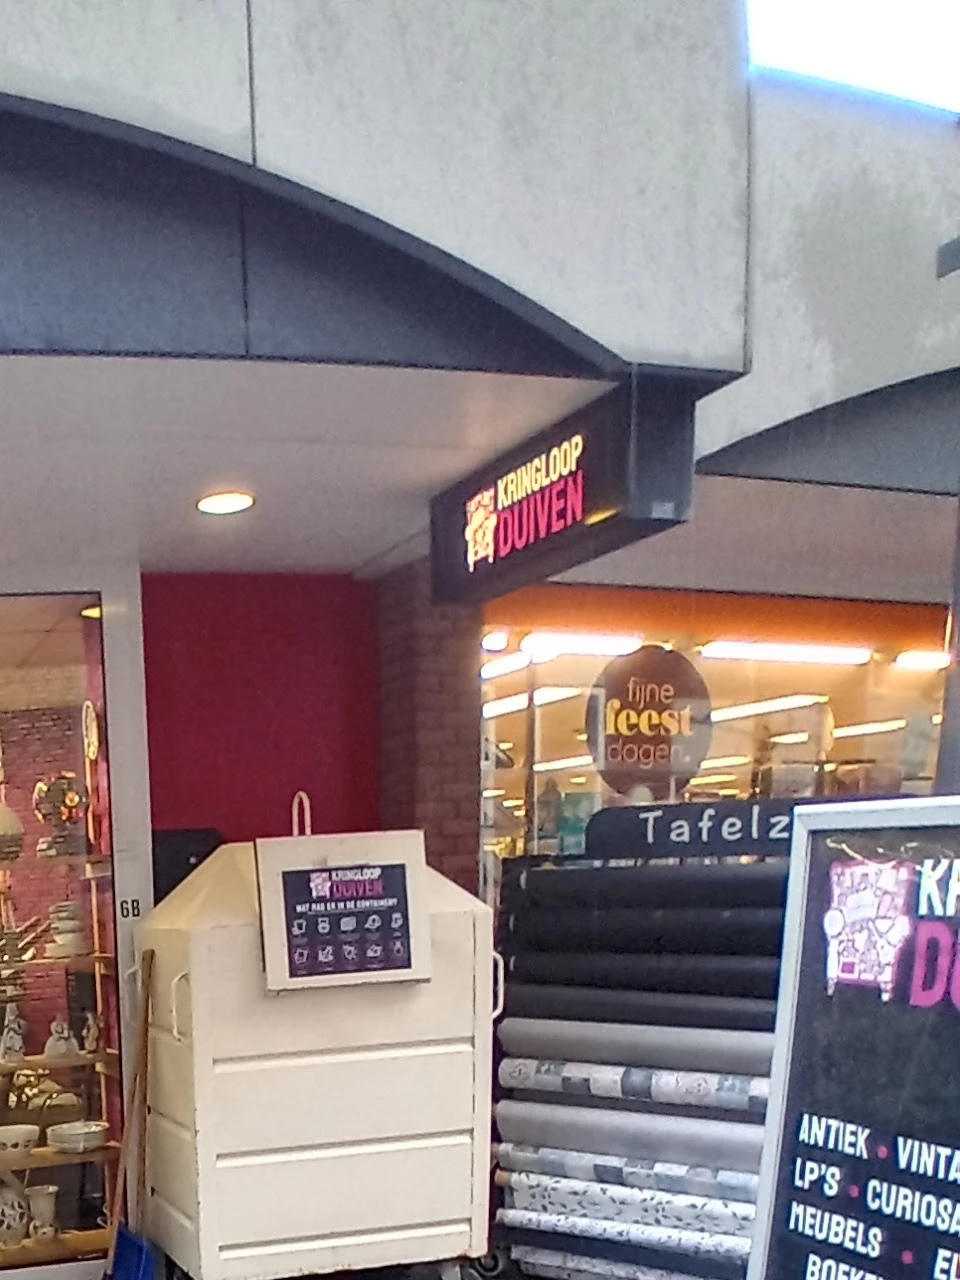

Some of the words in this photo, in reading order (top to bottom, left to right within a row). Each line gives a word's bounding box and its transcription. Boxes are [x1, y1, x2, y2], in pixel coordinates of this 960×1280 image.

[498, 434, 583, 510] KRINGLOOP
[498, 468, 584, 558] DUIVEN
[628, 676, 675, 709] fijne
[605, 698, 694, 737] feest
[120, 898, 141, 919] 6B
[798, 1113, 870, 1160] ANTIEK
[794, 1157, 841, 1198] LP'S
[788, 1200, 882, 1259] MEUBELS
